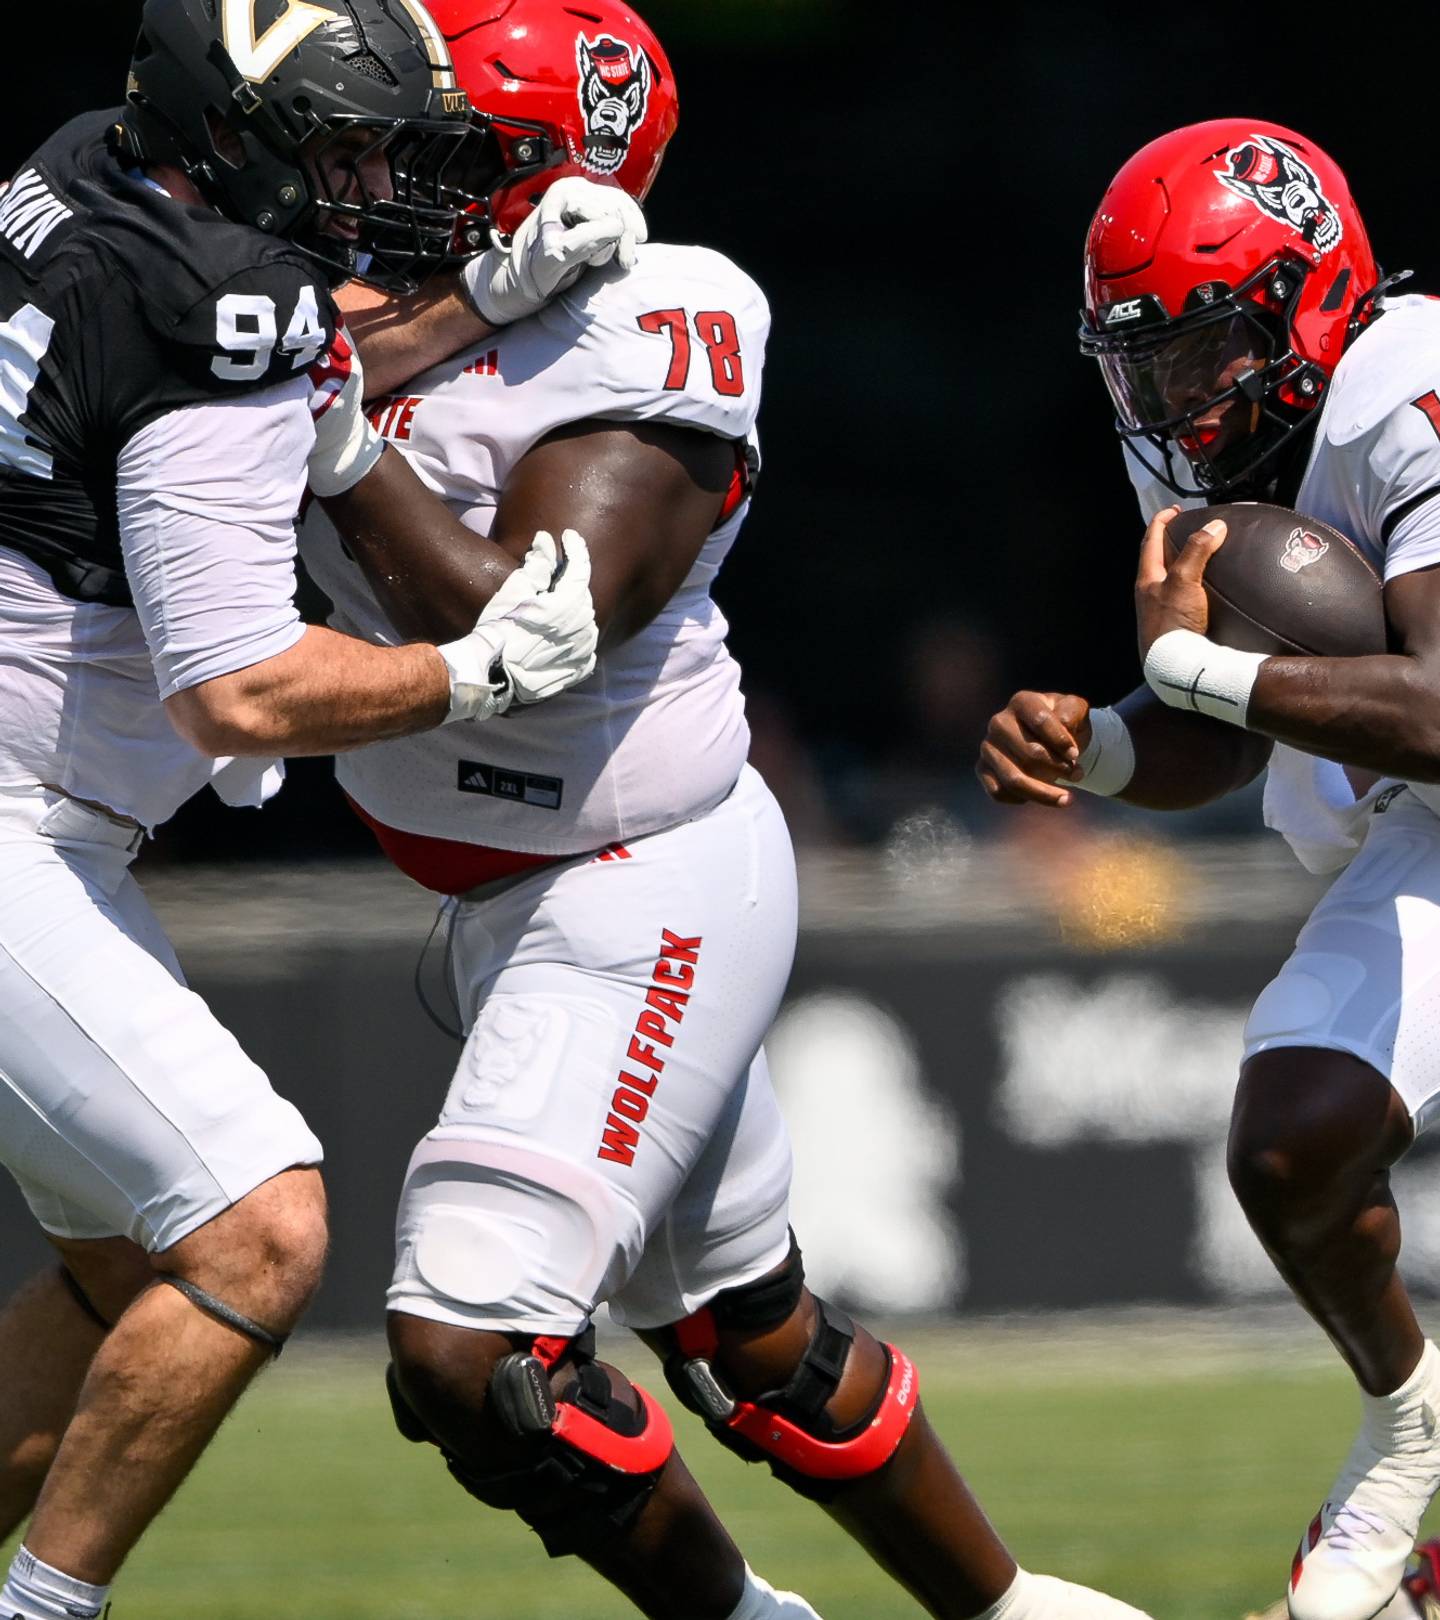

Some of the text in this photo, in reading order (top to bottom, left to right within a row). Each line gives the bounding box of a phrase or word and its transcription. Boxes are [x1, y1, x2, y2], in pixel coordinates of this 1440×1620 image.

[210, 285, 326, 381] 94
[636, 307, 744, 397] 78
[1105, 299, 1141, 324] ACC
[597, 927, 702, 1168] WOLFPACK
